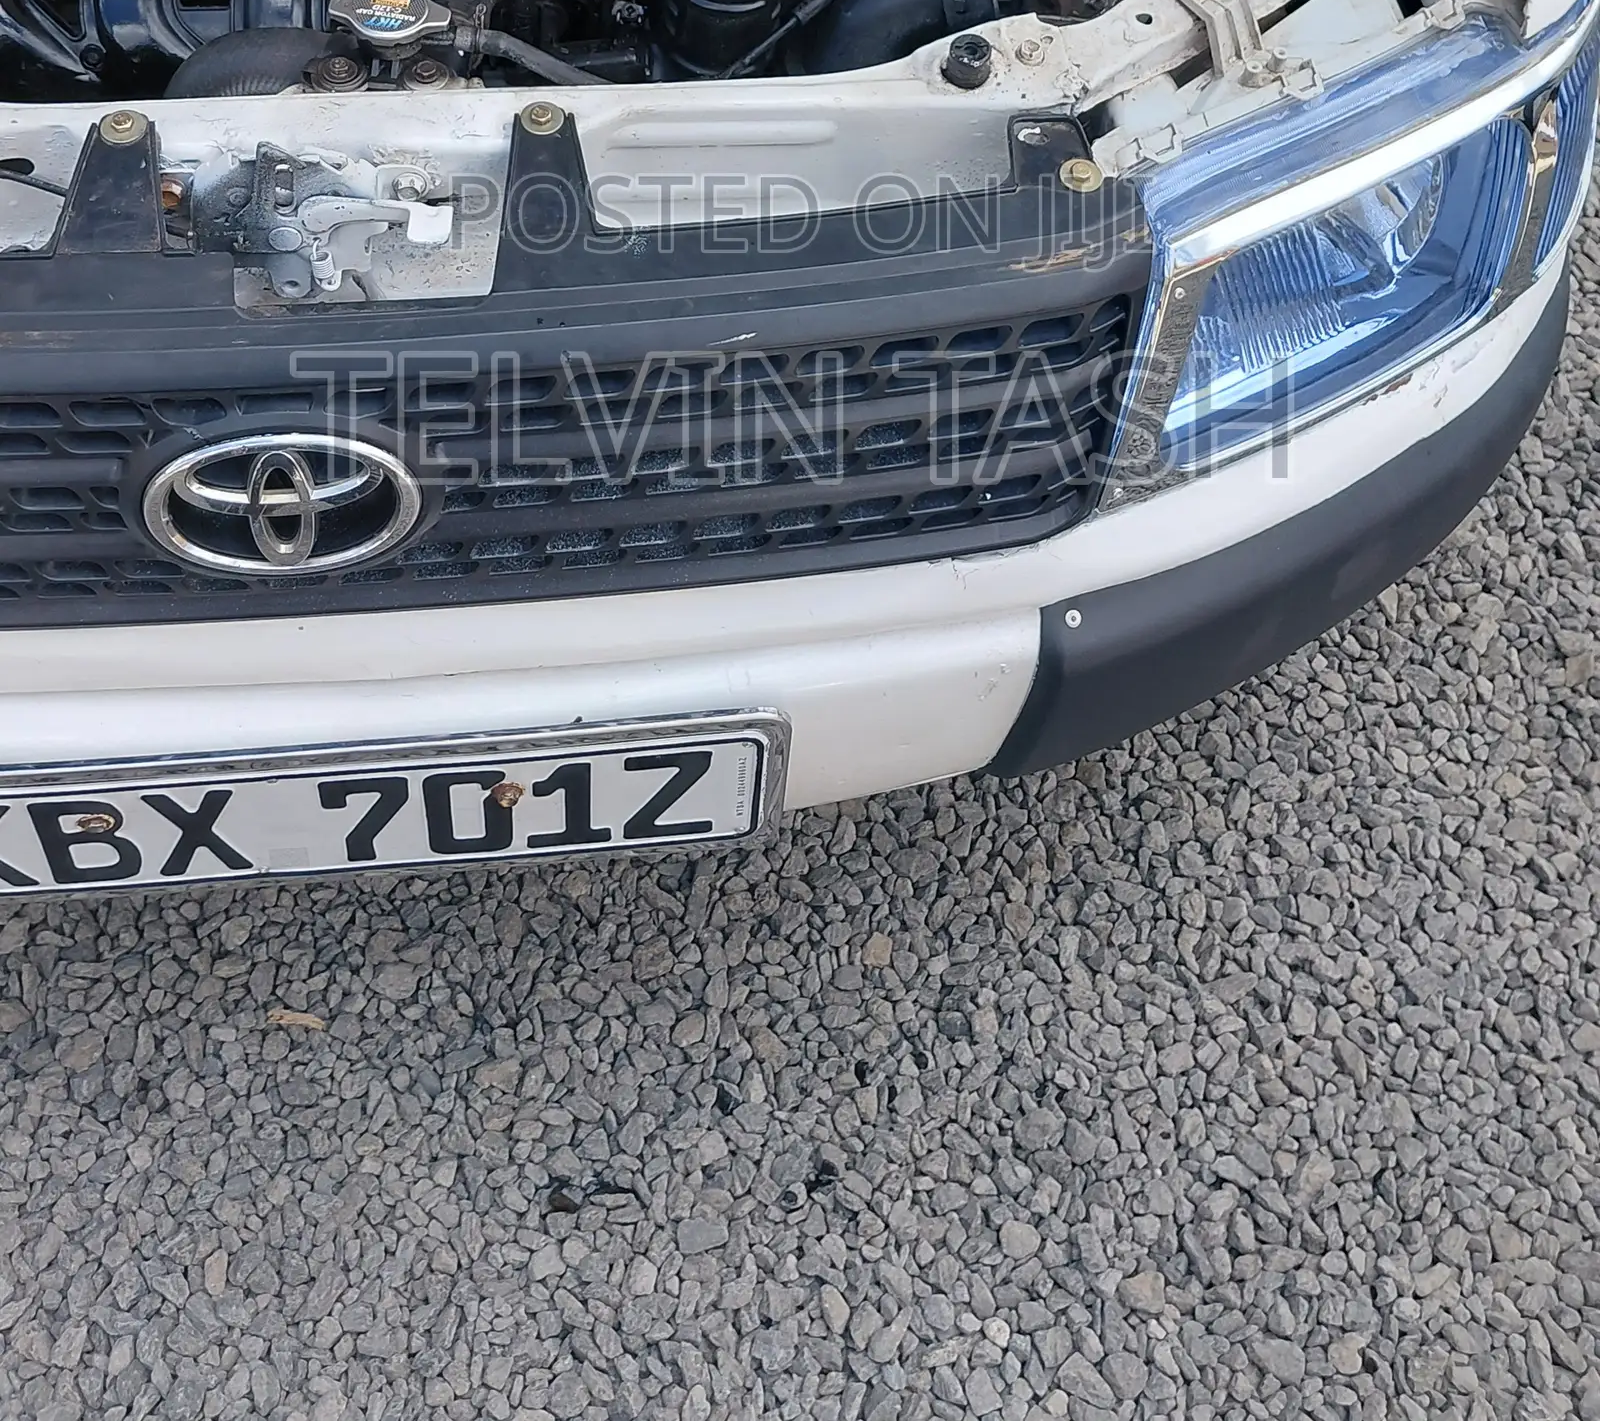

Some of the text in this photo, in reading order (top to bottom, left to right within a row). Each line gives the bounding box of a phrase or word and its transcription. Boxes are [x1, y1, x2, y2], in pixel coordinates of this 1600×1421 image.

[364, 16, 402, 29] HKT
[374, 12, 416, 21] RADIATOR
[318, 749, 713, 862] 701Z
